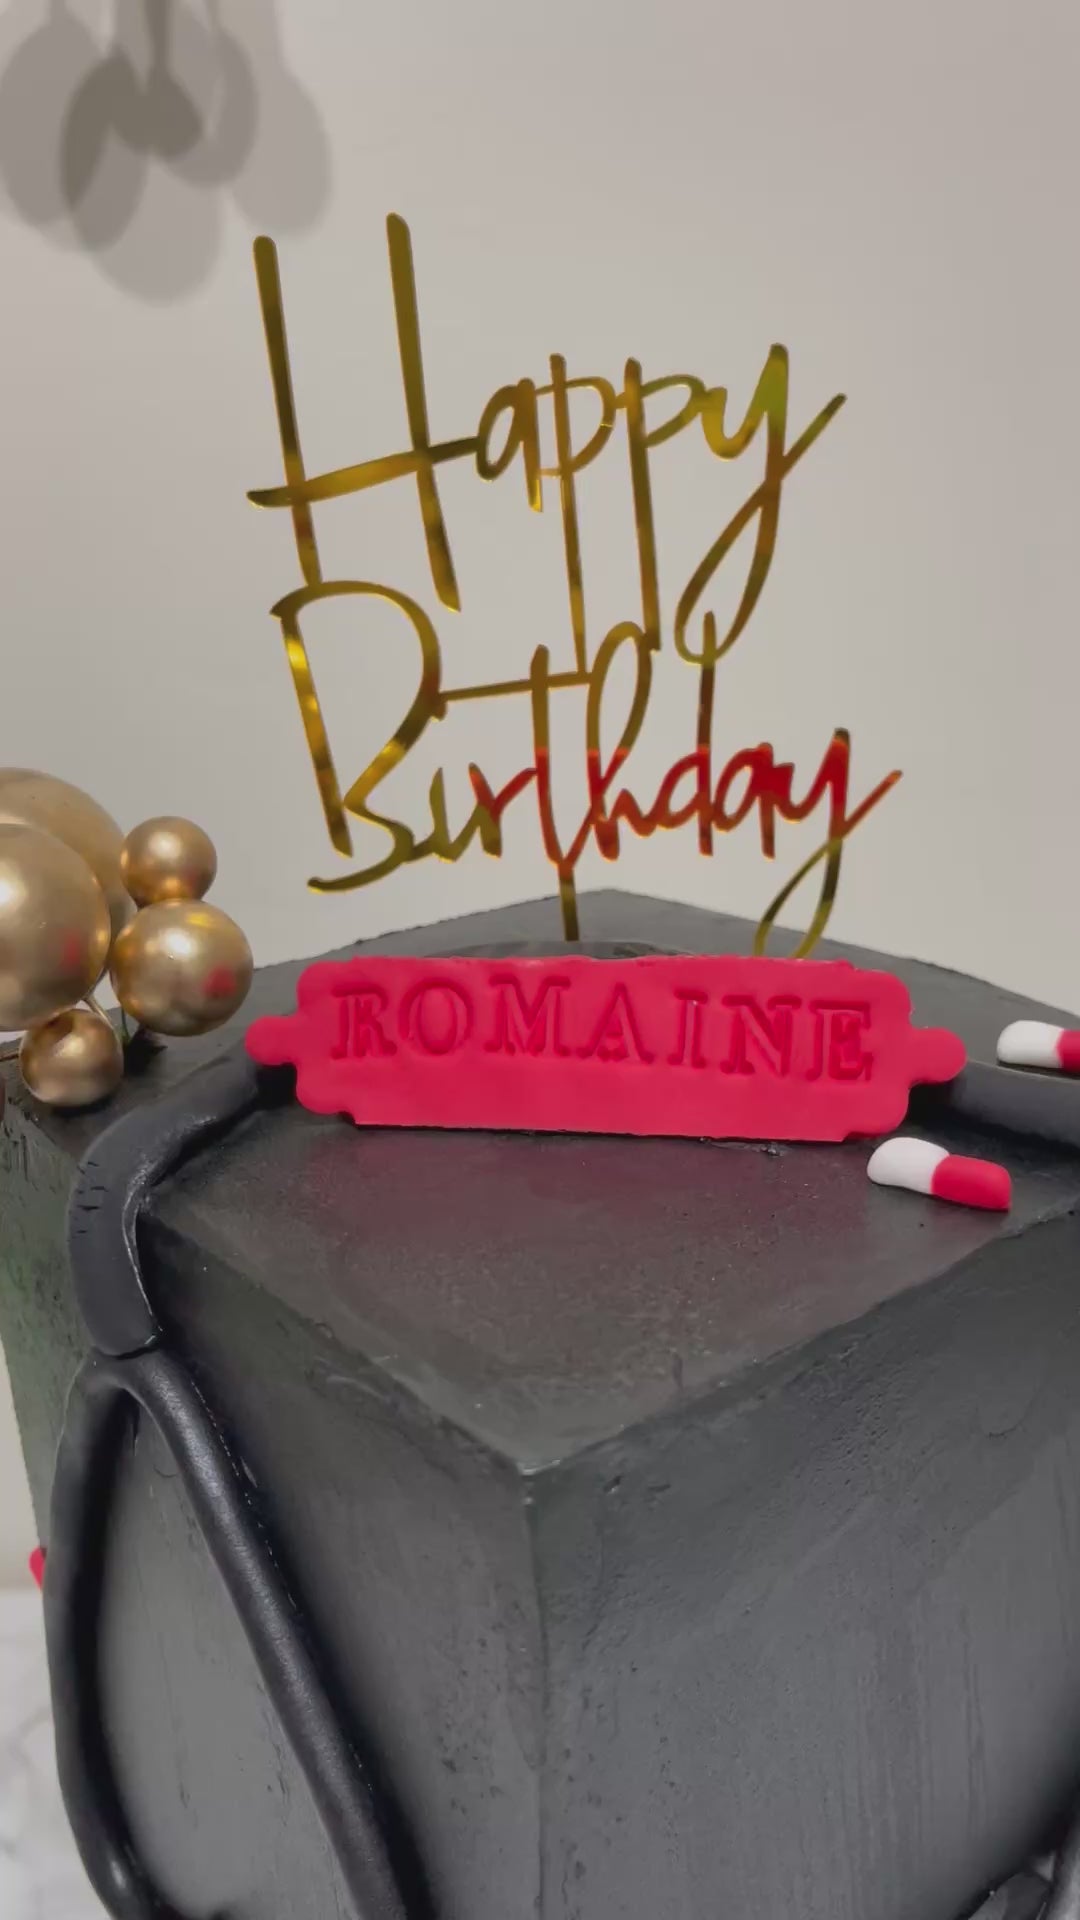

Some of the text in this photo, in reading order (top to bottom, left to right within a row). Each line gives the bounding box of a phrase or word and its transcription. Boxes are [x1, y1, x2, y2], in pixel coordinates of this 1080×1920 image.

[247, 212, 847, 666] Happy
[269, 580, 904, 957] Birthday
[330, 975, 875, 1083] ROMAINE
